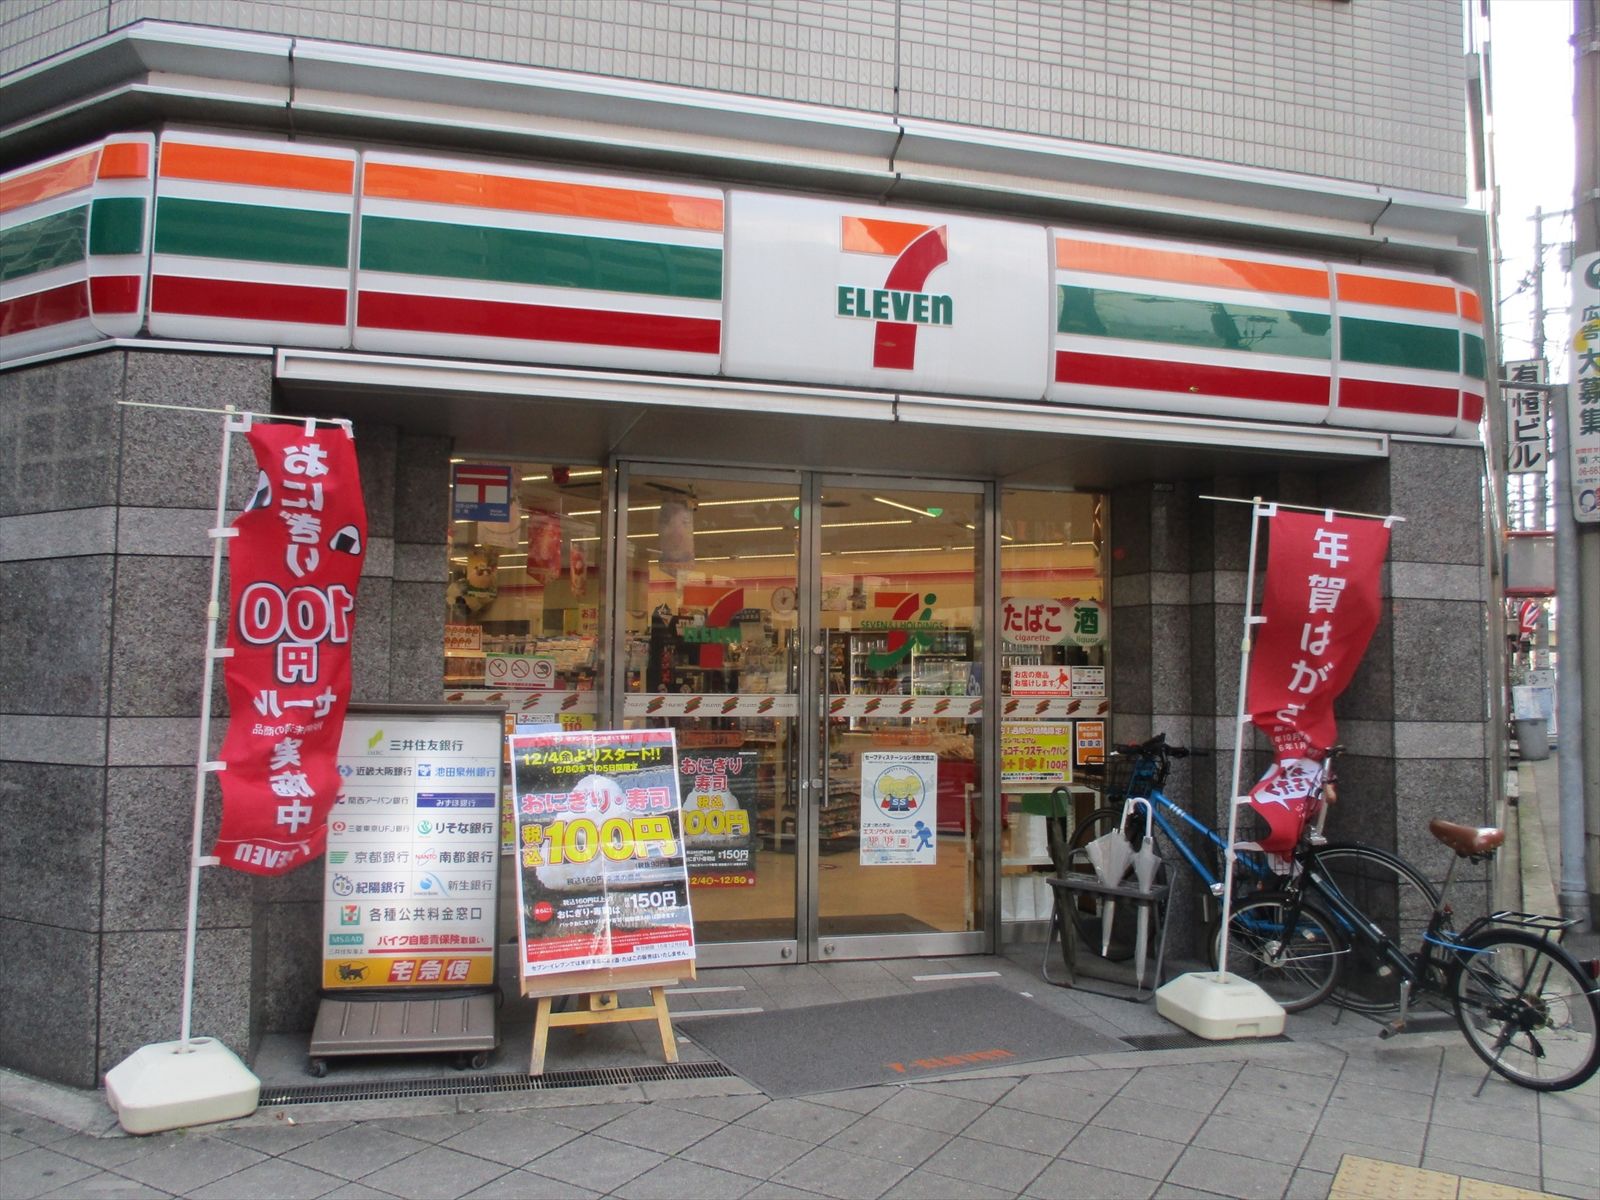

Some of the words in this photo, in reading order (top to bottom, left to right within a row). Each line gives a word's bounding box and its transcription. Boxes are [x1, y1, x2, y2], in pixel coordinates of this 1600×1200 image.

[841, 215, 949, 371] 7
[1003, 603, 1062, 633] たばこ
[1073, 607, 1099, 635] 酒
[1276, 528, 1350, 727] 年賀はがき
[1014, 634, 1051, 642] cigarette
[1013, 671, 1050, 679] お店の商品
[389, 739, 464, 752] 三井住友銀行
[355, 766, 412, 776] 近畿大阪銀行
[435, 767, 496, 777] 池田泉州銀行
[680, 756, 743, 774] おにぎり
[694, 775, 728, 792] 寿司
[348, 796, 409, 805] 関西アーバン銀行
[435, 799, 476, 807] みずほ銀行
[348, 825, 410, 833] 三菱東京UFJ銀行
[435, 822, 494, 834] りそな銀行
[521, 824, 543, 868] 税込
[543, 818, 679, 864] 100円
[354, 851, 410, 864] 京都銀行
[439, 851, 494, 864] 南都銀行
[721, 850, 749, 859] 150円
[355, 881, 405, 894] 紀陽銀行
[447, 879, 493, 892] 新生銀行
[630, 890, 678, 908] 150円
[369, 907, 482, 922] 各種公共料金窓口
[389, 959, 472, 982] 宅急便
